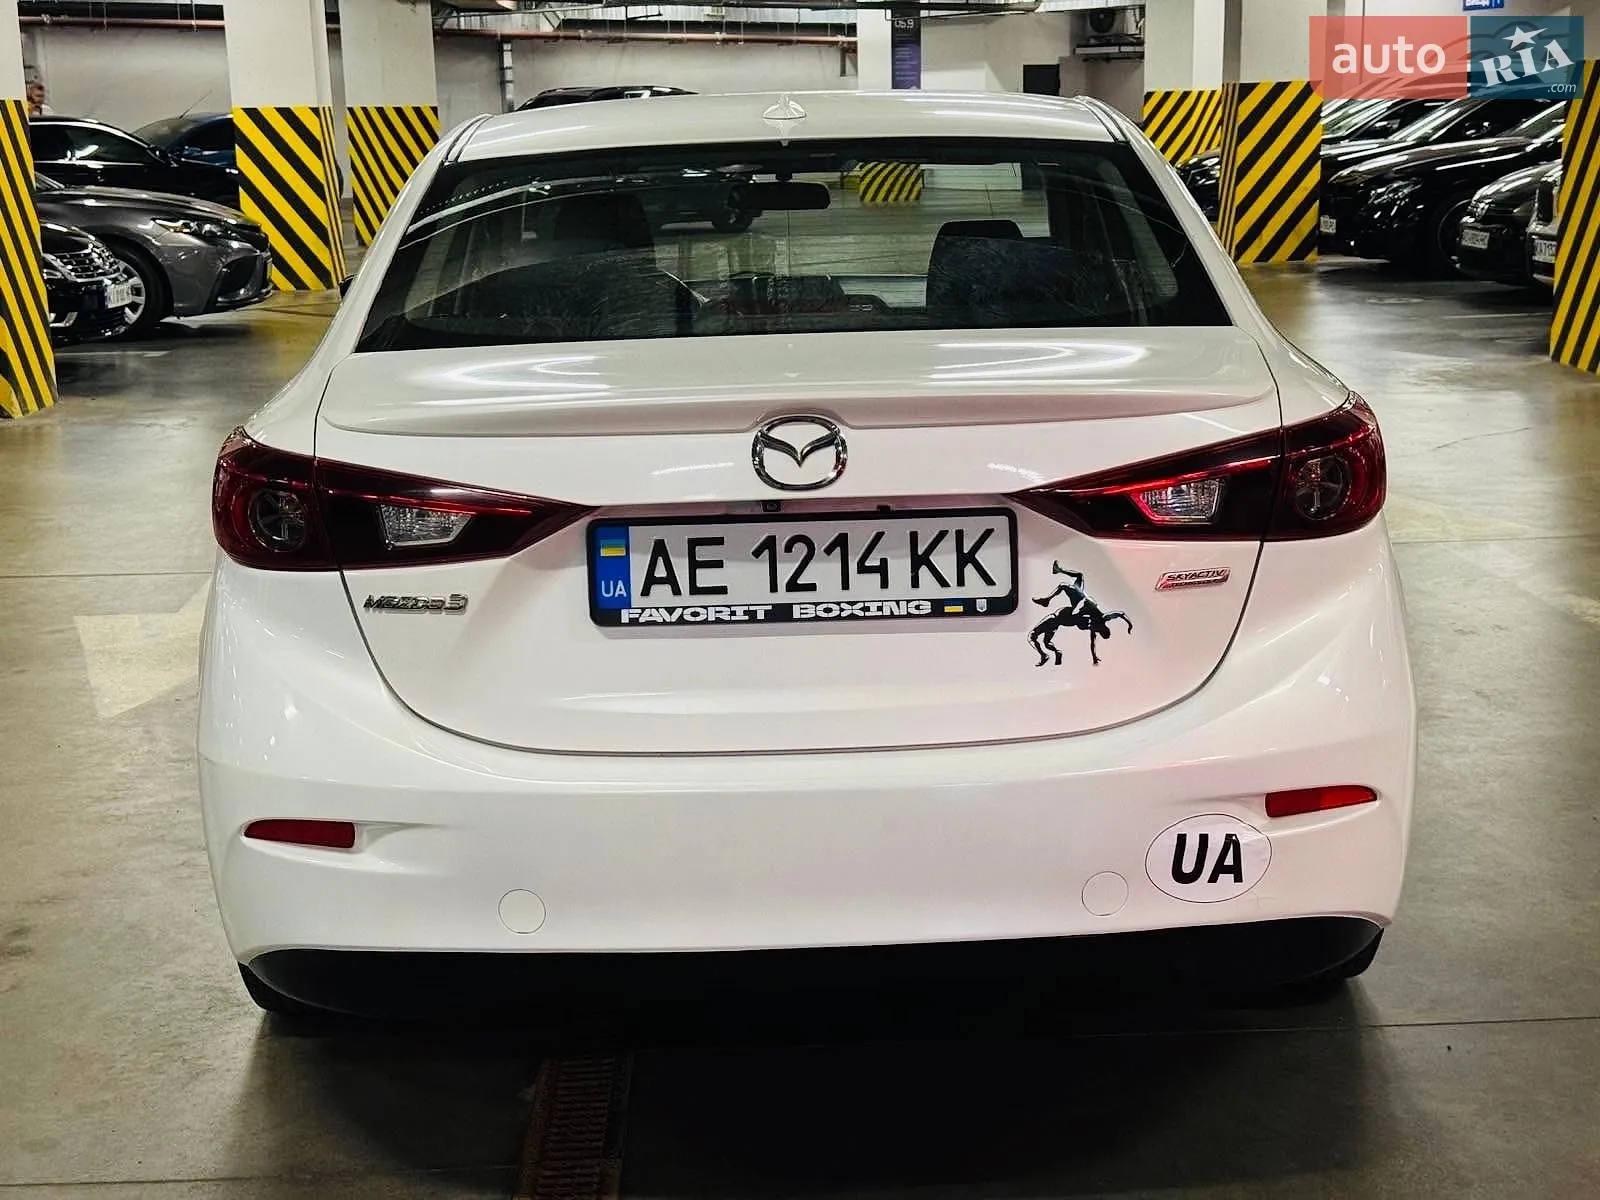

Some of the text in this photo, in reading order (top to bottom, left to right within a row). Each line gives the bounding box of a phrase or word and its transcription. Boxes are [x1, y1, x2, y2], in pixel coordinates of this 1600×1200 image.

[640, 528, 997, 597] AE 1214 KK
[1166, 568, 1226, 581] SKYACTIV
[601, 580, 627, 598] UA
[620, 600, 932, 624] FAVORIT BOXING
[1171, 833, 1244, 885] UA
